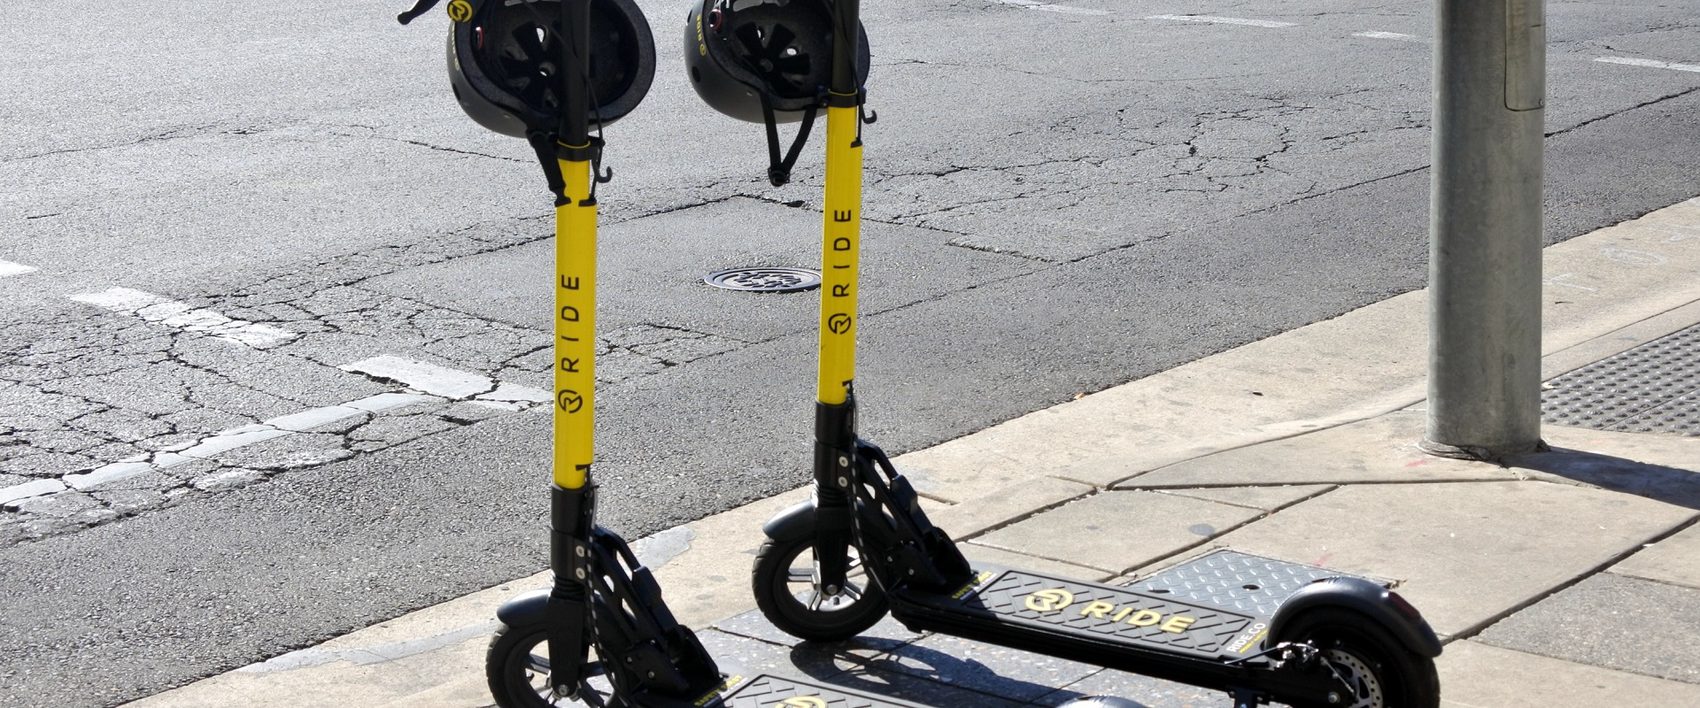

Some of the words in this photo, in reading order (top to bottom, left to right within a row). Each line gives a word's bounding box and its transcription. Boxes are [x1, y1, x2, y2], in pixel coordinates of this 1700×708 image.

[832, 209, 852, 297] RIDE
[561, 274, 580, 373] RIDE
[1080, 601, 1196, 634] RIDE
